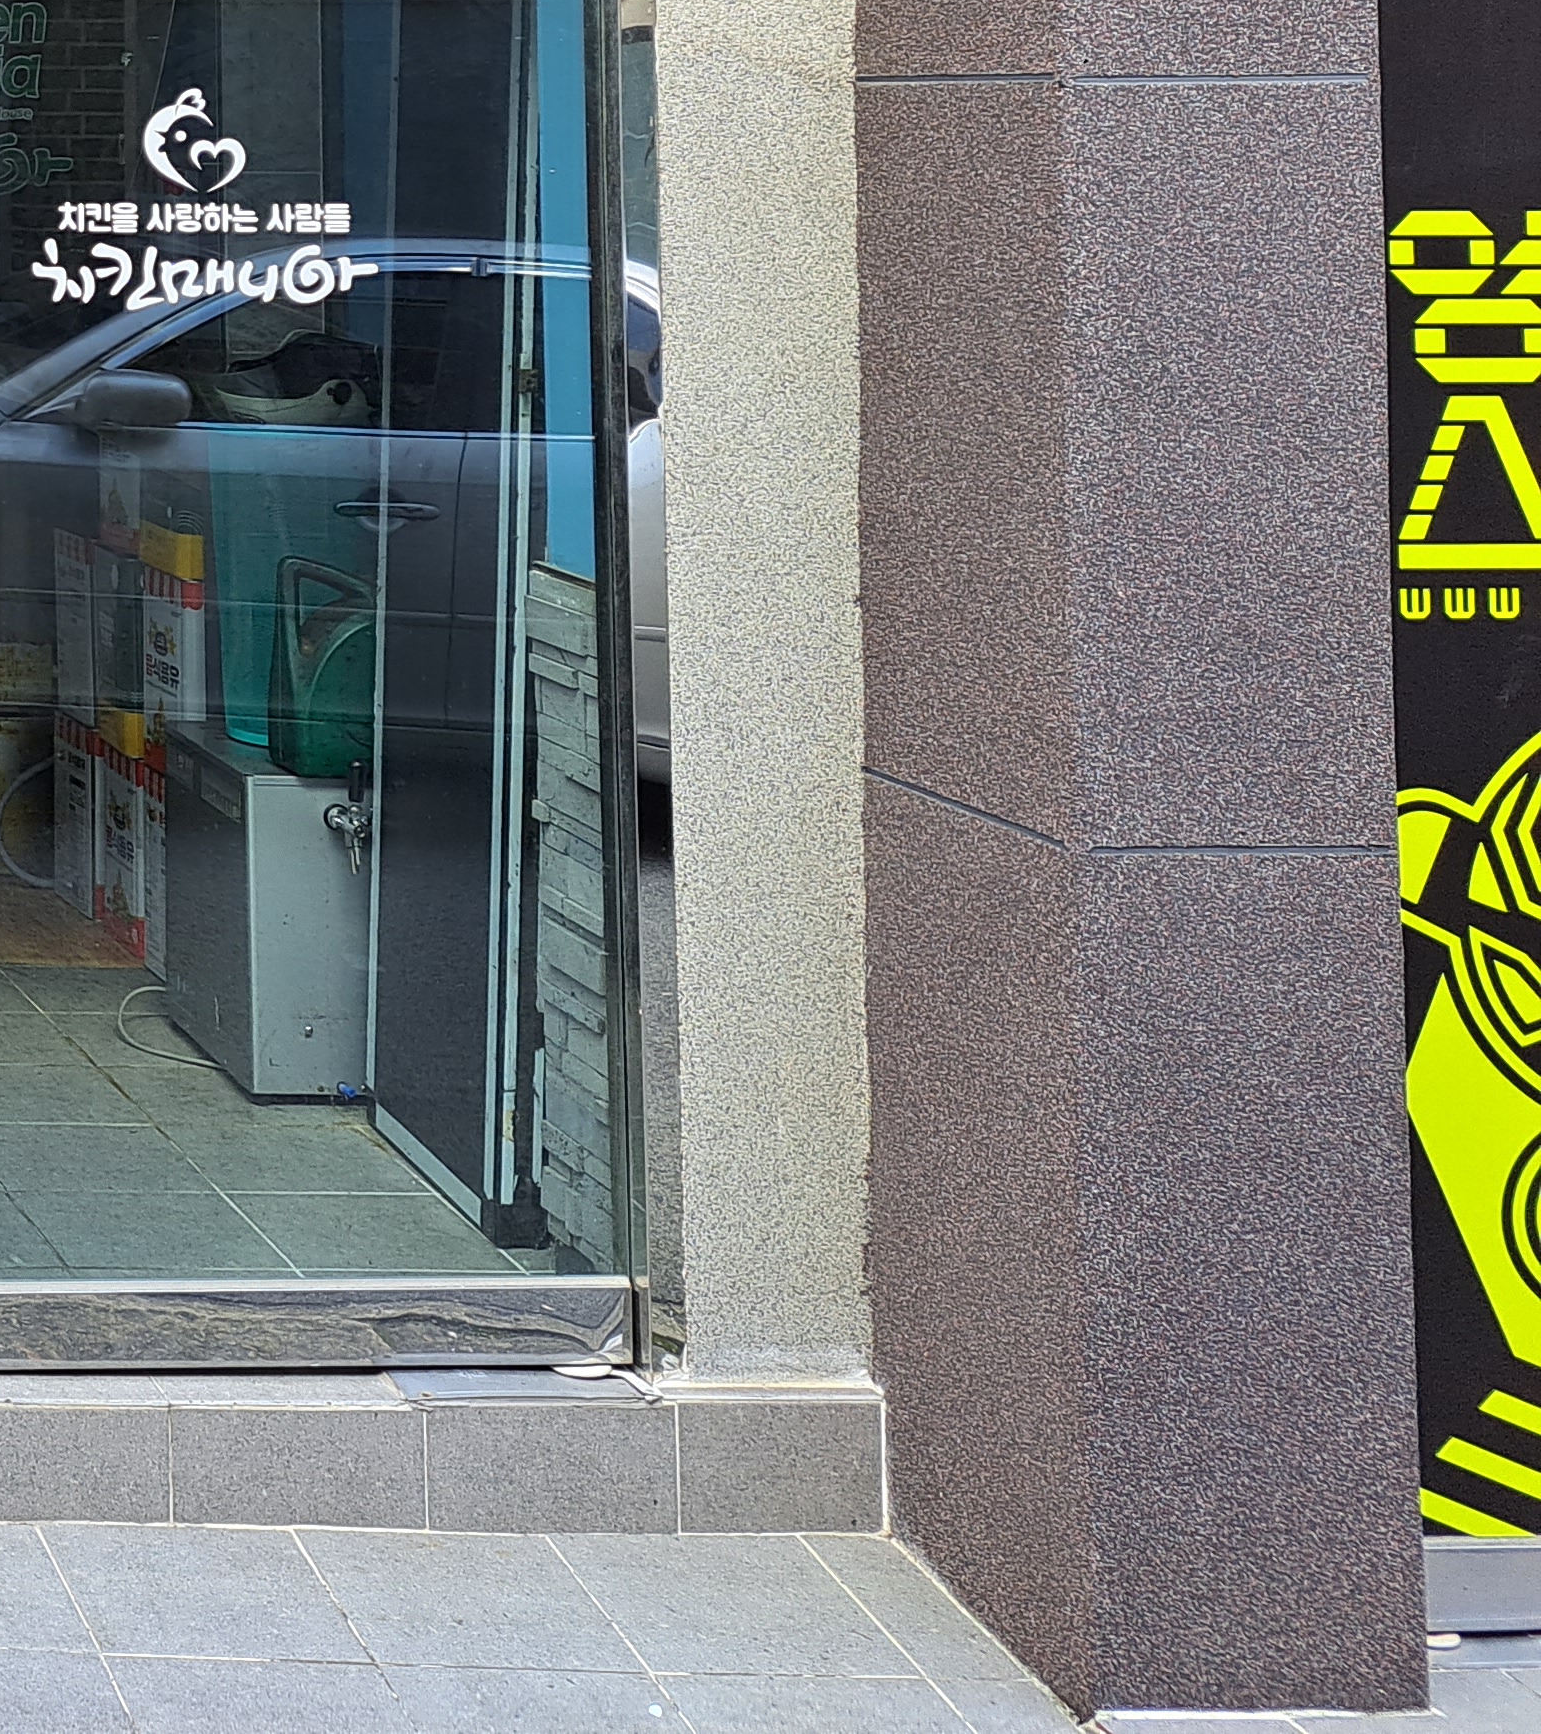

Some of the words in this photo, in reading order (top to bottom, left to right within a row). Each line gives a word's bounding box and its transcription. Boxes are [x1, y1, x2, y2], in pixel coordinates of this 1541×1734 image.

[58, 202, 139, 234] 치킨을
[147, 203, 258, 233] 사랑하는
[267, 203, 351, 233] 사람들
